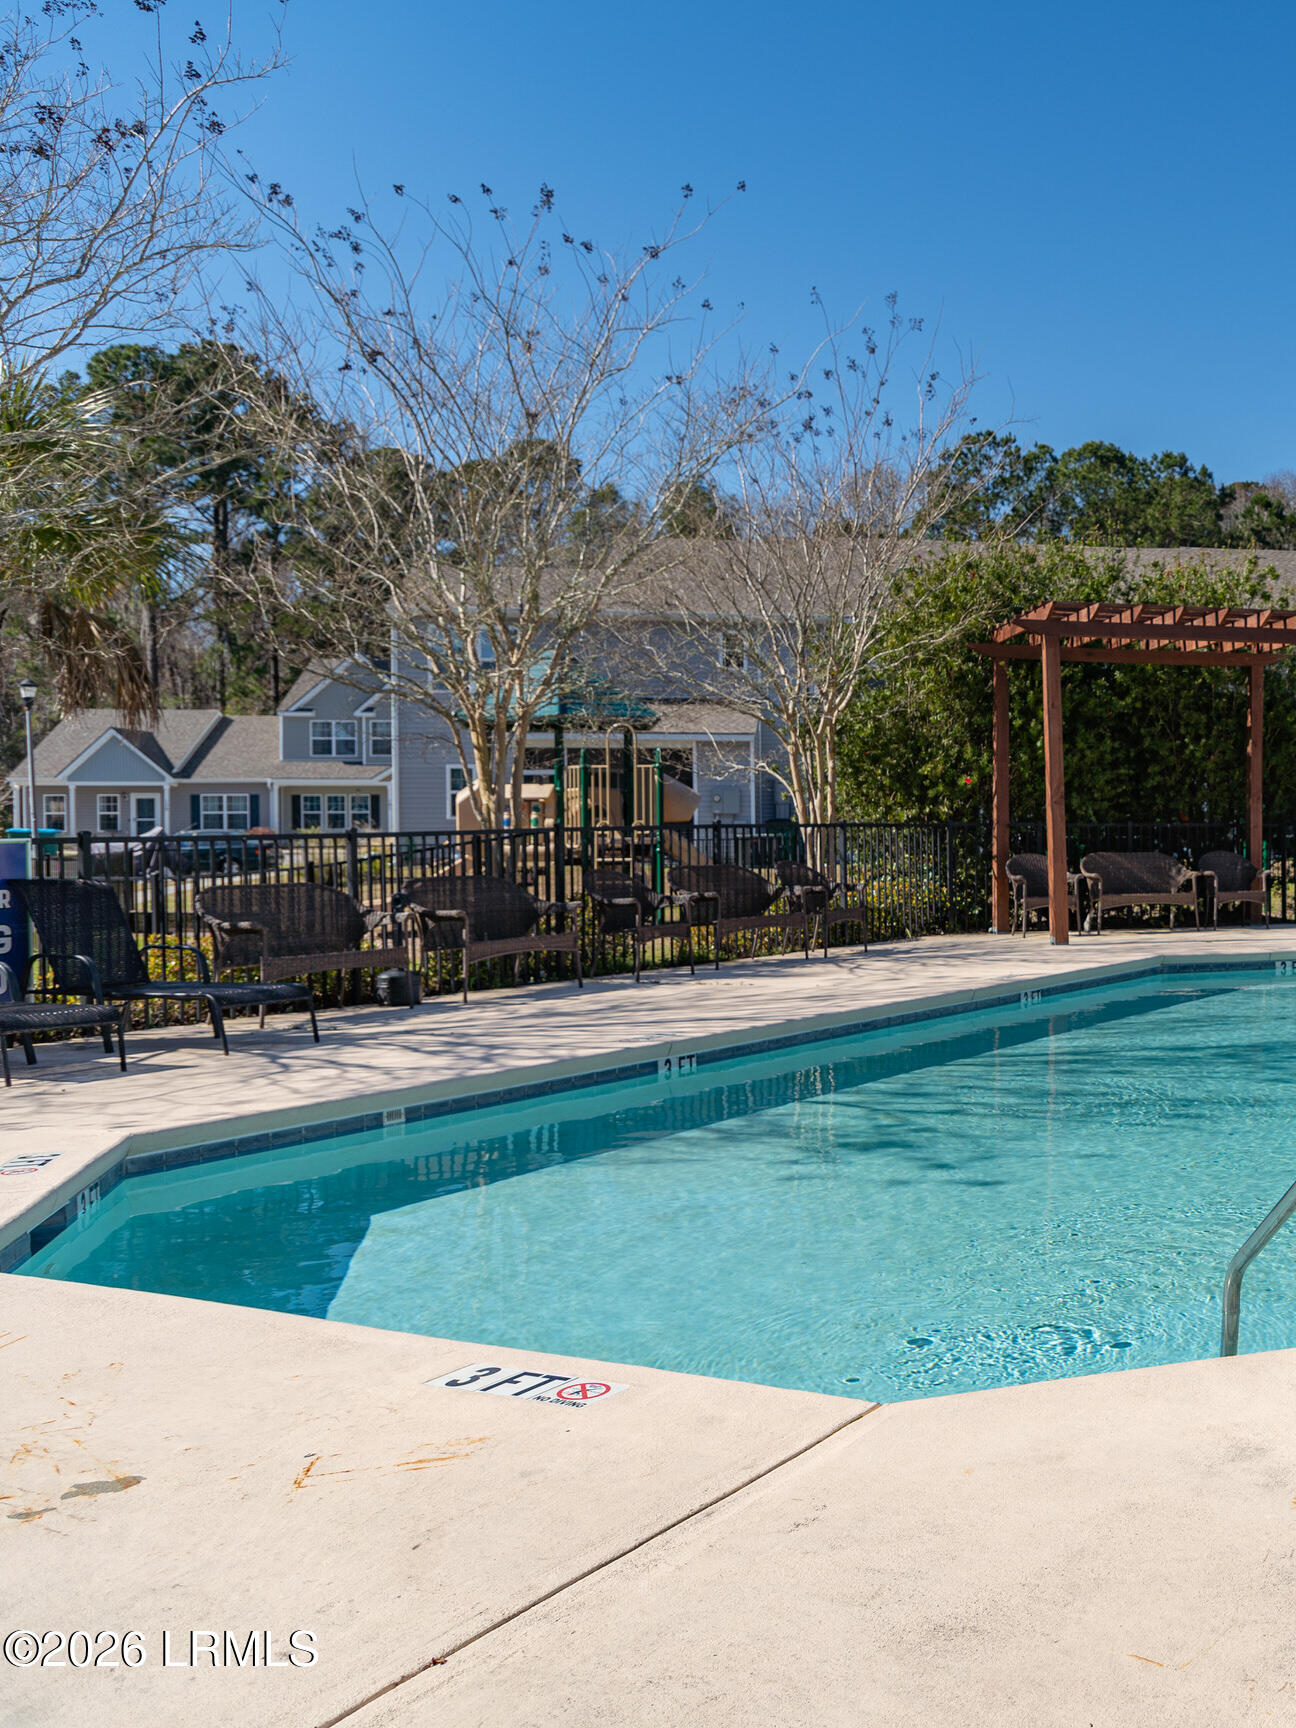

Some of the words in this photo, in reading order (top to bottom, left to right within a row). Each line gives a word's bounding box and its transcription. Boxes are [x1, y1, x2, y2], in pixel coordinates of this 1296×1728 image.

[678, 1055, 695, 1074] FT
[444, 1367, 502, 1387] 3
[480, 1371, 572, 1397] FT
